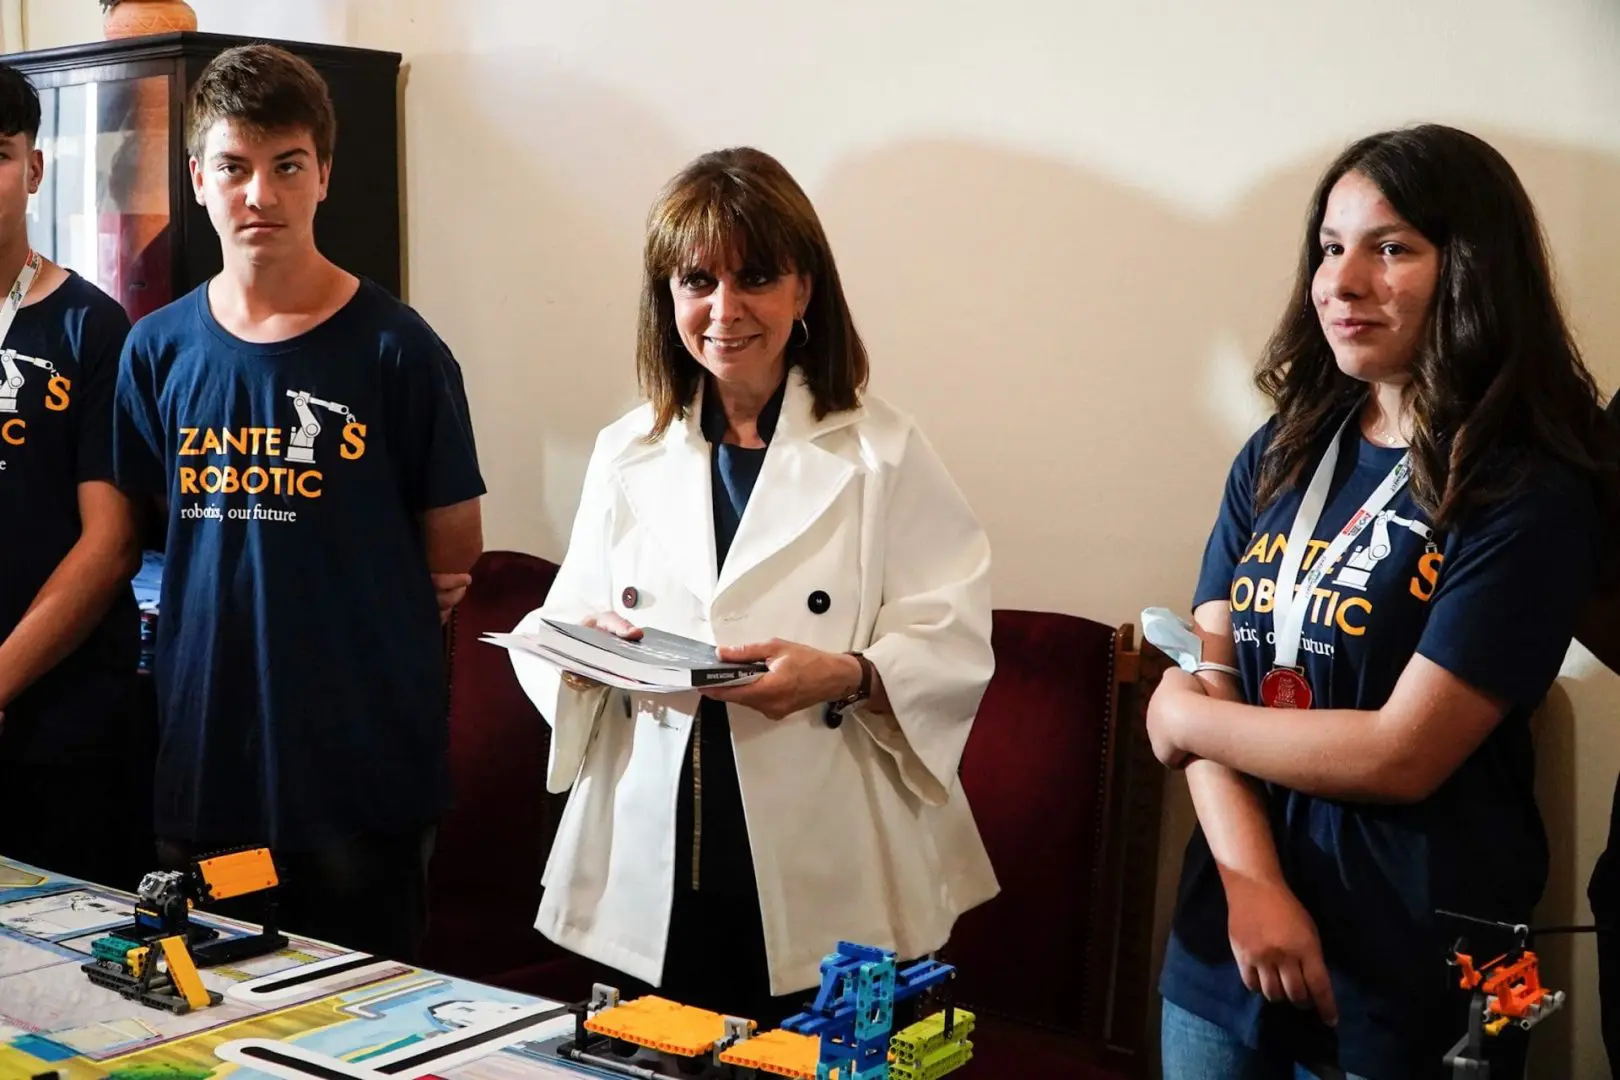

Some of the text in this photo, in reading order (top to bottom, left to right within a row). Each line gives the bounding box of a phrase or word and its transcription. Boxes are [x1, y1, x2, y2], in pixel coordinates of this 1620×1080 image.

[178, 422, 367, 460] ZANTE S
[179, 466, 323, 498] ROBOTIC
[228, 508, 251, 519] our
[253, 503, 297, 522] future
[1229, 576, 1373, 636] OBTIC
